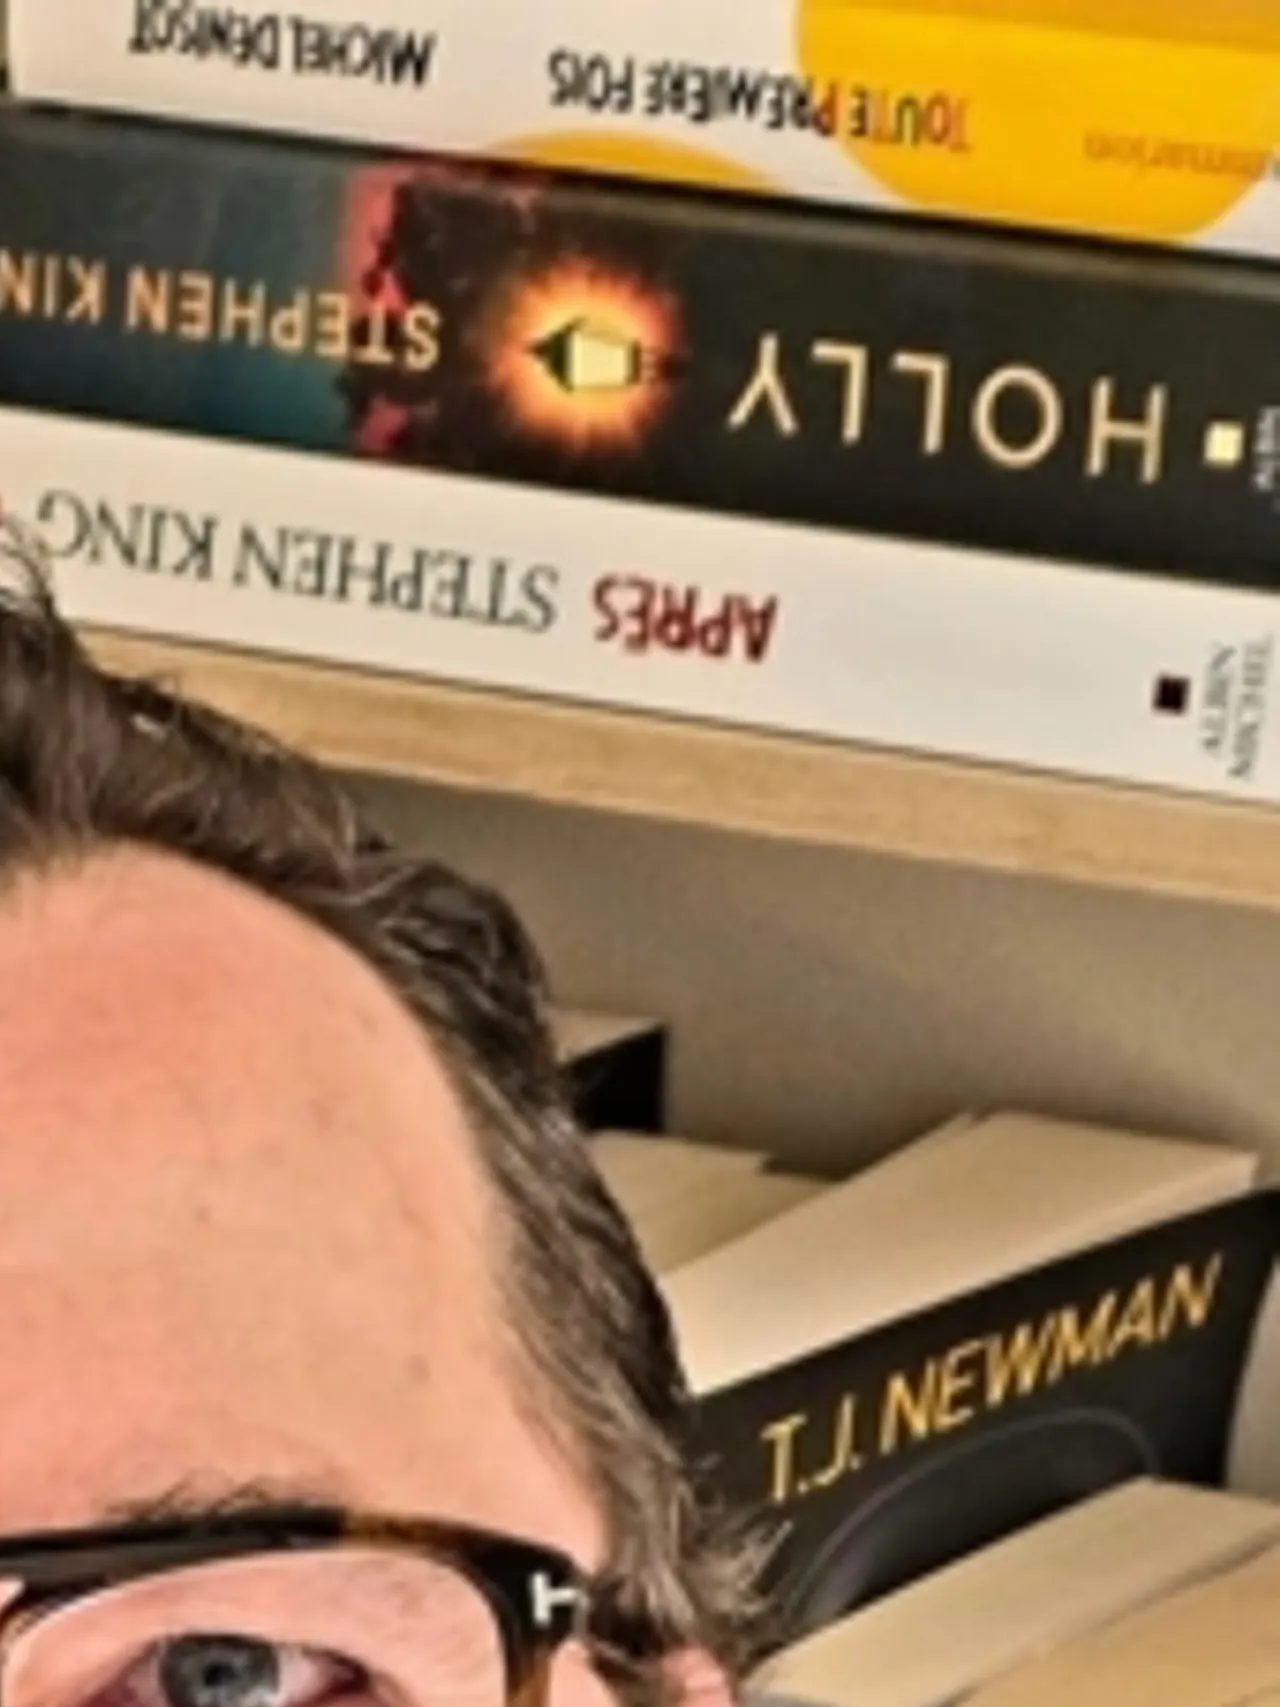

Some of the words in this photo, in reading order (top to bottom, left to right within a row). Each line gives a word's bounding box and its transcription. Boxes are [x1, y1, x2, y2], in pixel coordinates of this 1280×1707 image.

[127, 0, 280, 74] DENISOT
[288, 14, 437, 88] MICHEL
[547, 49, 637, 115] FOIS
[643, 65, 838, 137] PREMIÈRE
[849, 88, 972, 153] TOUTE
[126, 267, 442, 374] STEPHEN
[729, 328, 1168, 485] HOLLY
[34, 488, 228, 584] KING
[240, 519, 561, 636] STEPHEN
[590, 570, 778, 664] APRÈS
[760, 1390, 862, 1505] T.J.
[879, 1252, 1224, 1457] NEWMAN
